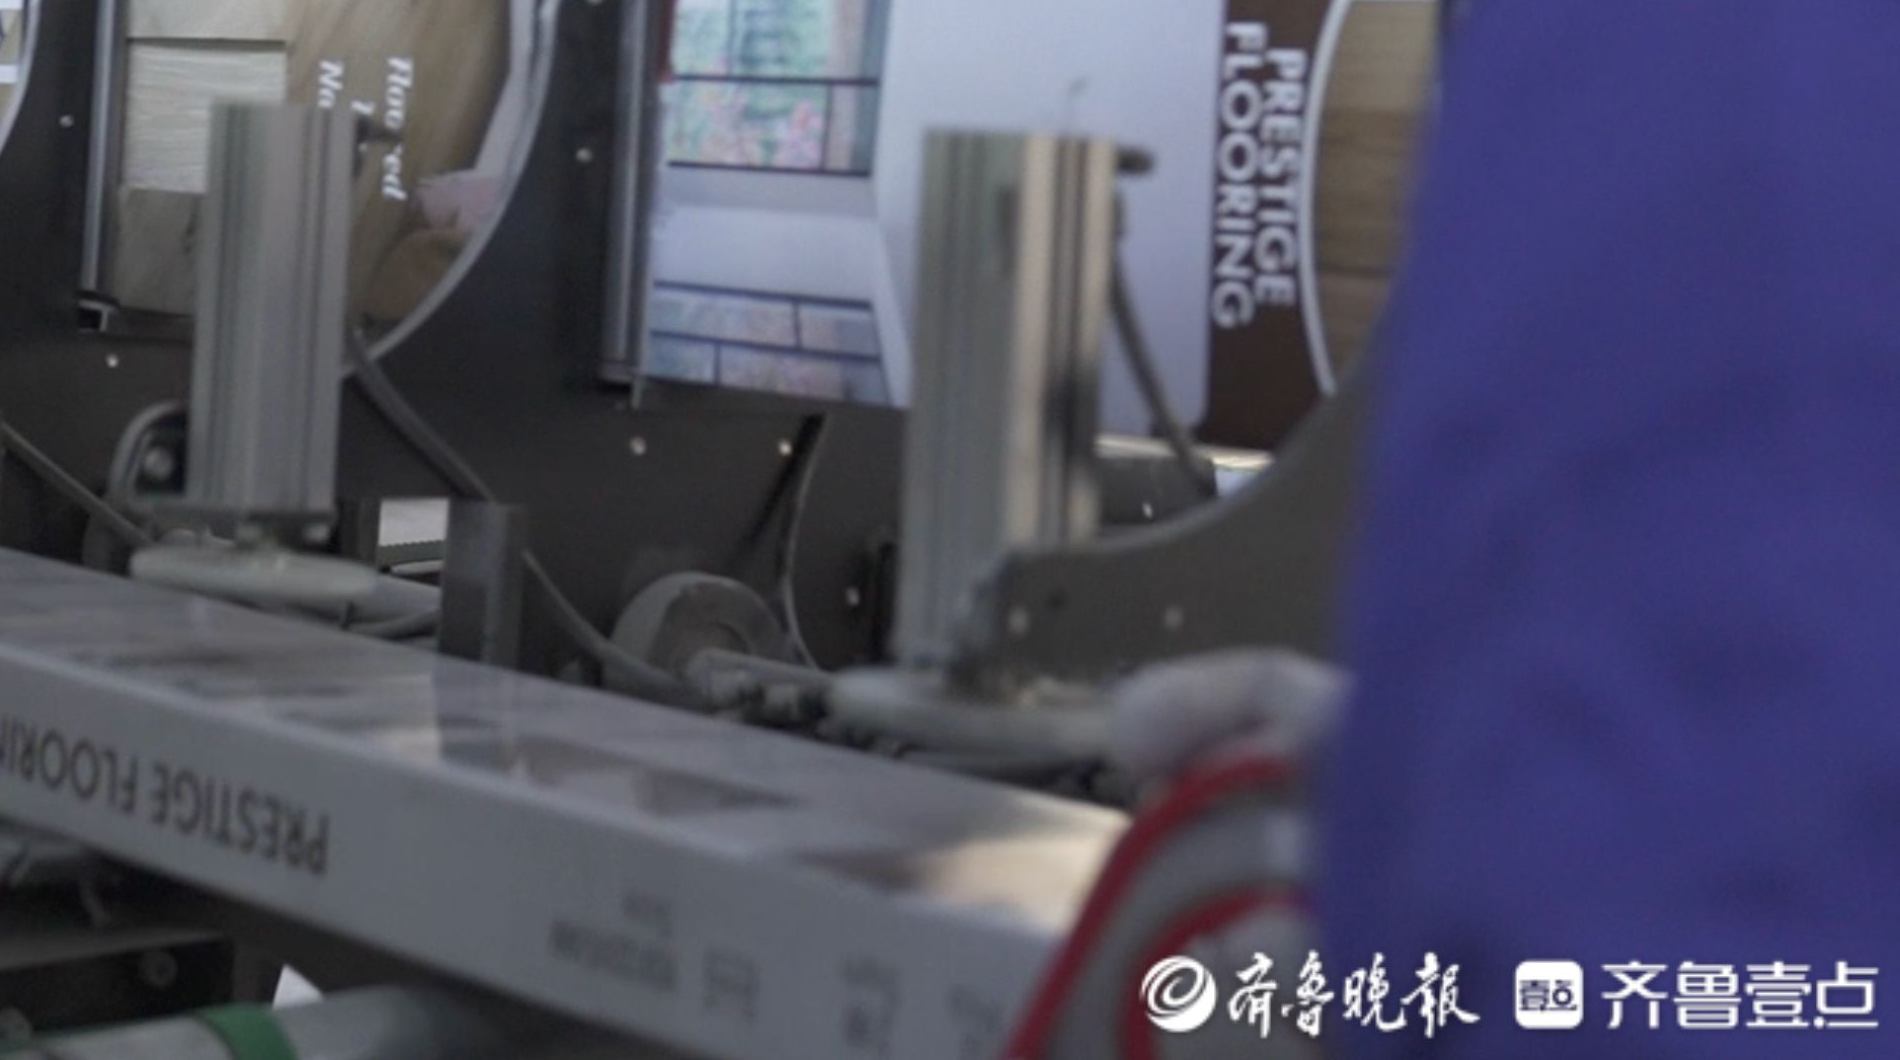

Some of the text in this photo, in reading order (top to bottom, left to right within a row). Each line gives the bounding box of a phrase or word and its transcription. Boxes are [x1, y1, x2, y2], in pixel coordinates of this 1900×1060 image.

[1210, 21, 1268, 329] FLOORING
[1254, 48, 1307, 307] PRESTIGE
[151, 761, 329, 876] PRESTIGE
